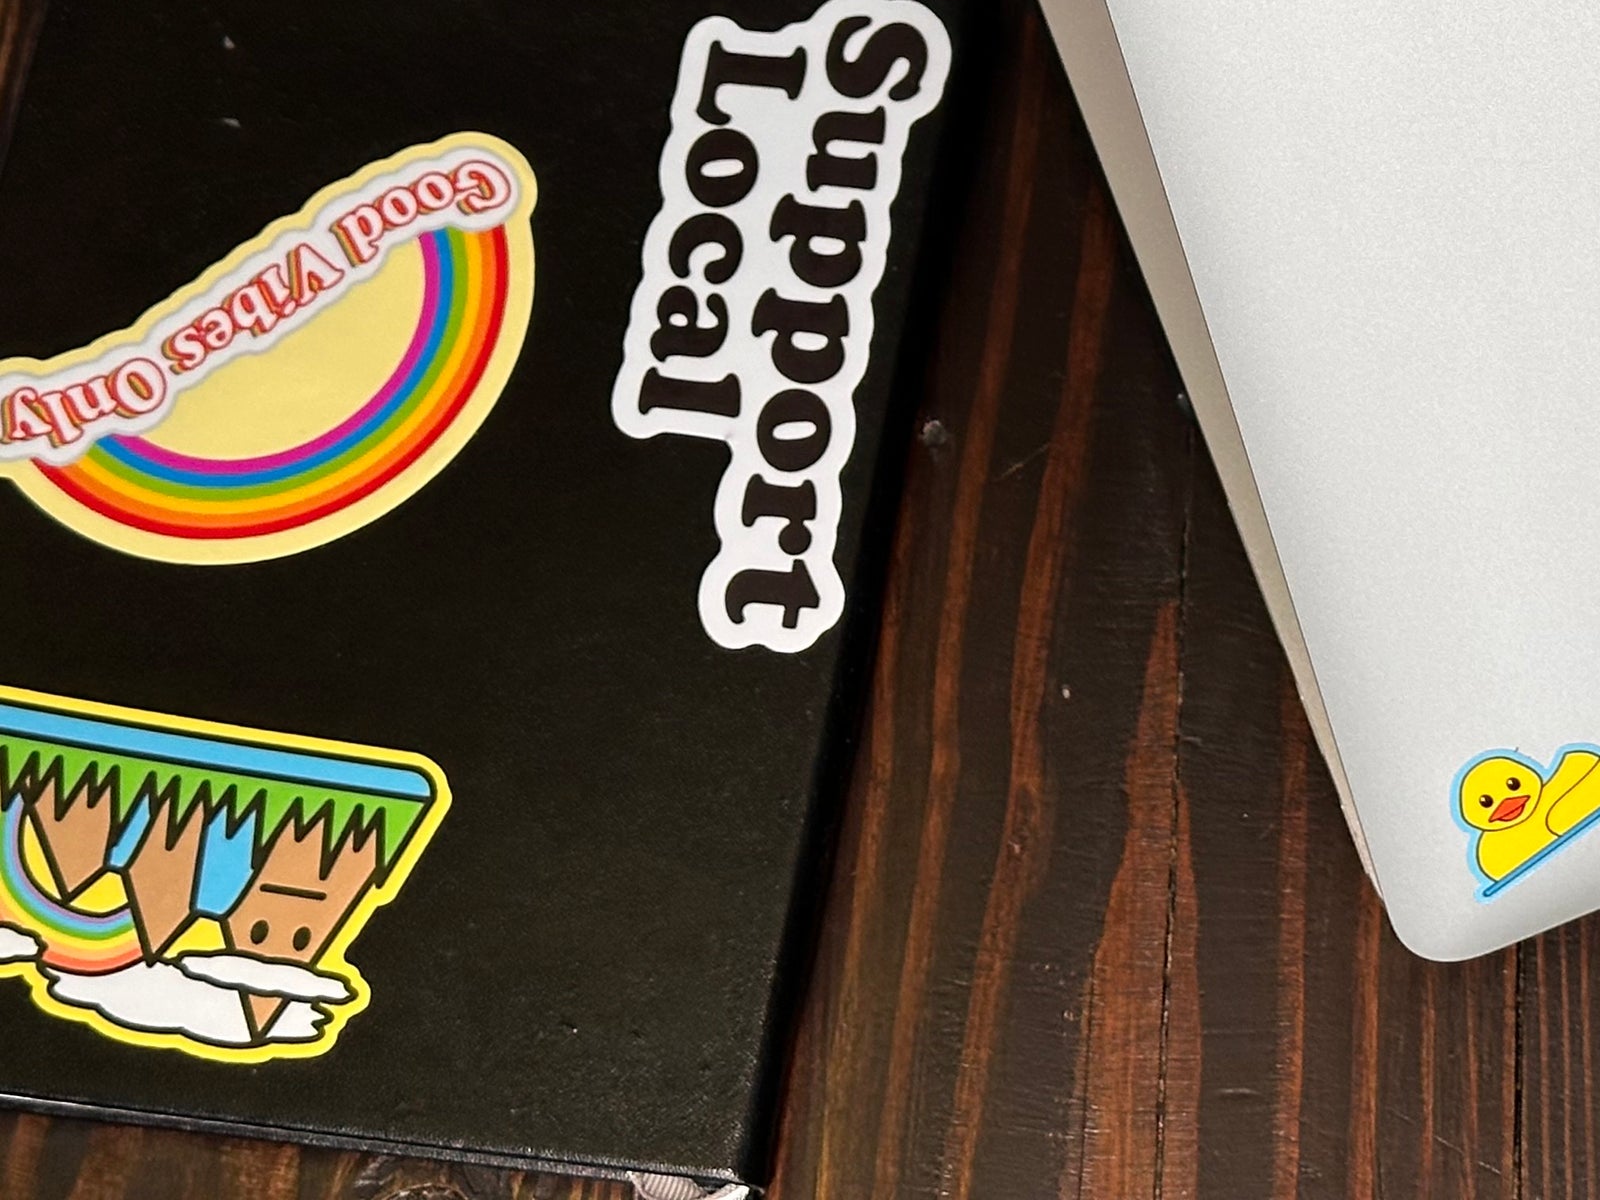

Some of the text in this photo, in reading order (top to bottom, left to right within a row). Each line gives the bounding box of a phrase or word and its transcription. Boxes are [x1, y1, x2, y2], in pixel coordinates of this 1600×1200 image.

[1, 160, 512, 448] Good Vibes Only
[638, 39, 808, 433] Local
[723, 14, 928, 630] Support
